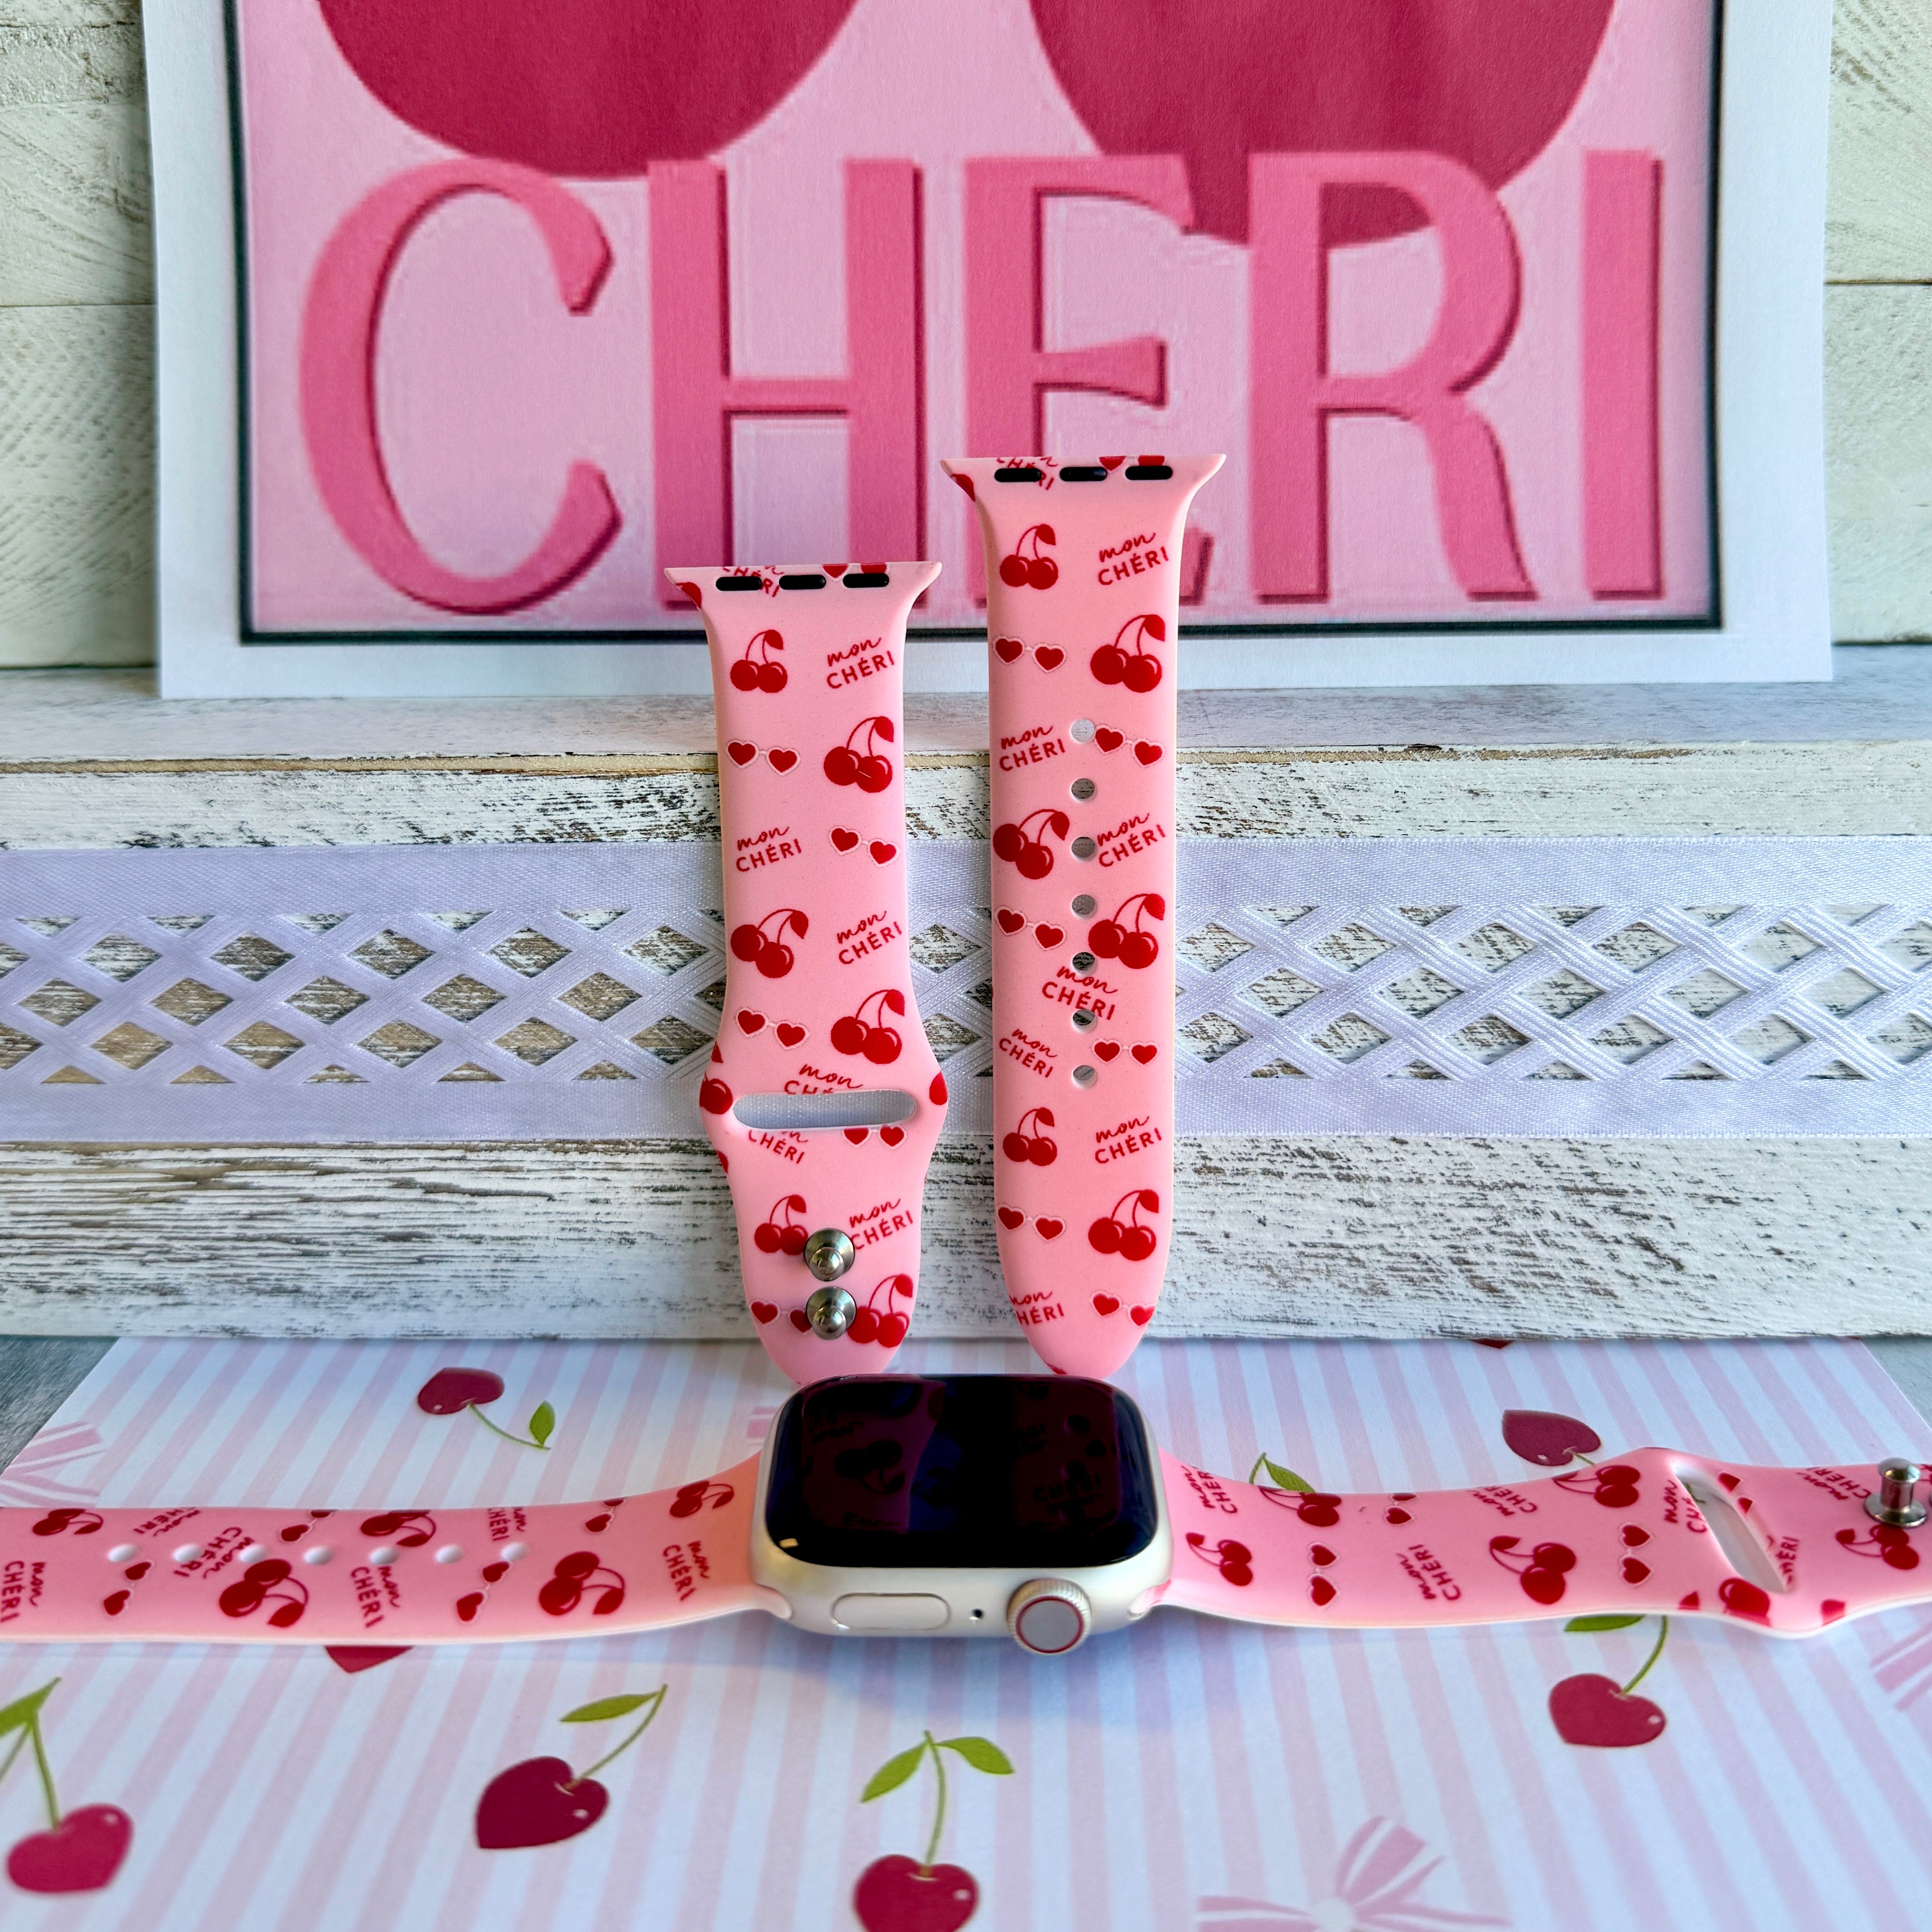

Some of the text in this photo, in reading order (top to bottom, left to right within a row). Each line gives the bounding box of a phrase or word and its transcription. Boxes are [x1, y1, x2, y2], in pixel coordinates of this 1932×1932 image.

[298, 148, 1664, 615] CHERI
[1097, 546, 1169, 586] CHÉRI
[1099, 533, 1156, 563] mon
[826, 650, 894, 689] CHÉRI
[827, 637, 882, 667] mon
[999, 738, 1066, 772] CHÉRI
[1001, 726, 1054, 750] mon
[737, 826, 790, 852] mon
[1096, 813, 1150, 847] mon
[1098, 824, 1166, 868] CHÉRI
[735, 838, 802, 872] CHÉRI
[836, 910, 887, 944] mon
[838, 921, 902, 965] CHÉRI
[1056, 966, 1118, 994] mon
[1042, 981, 1116, 1021] CHÉRI
[997, 1037, 1054, 1078] CHÉRI
[1011, 1028, 1058, 1058] mon
[798, 1063, 863, 1089] mon
[1094, 1127, 1162, 1164] CHÉRI
[1095, 1116, 1150, 1144] mon
[849, 1198, 901, 1228] mon
[850, 1210, 913, 1250] CHÉRI
[1016, 1302, 1065, 1325] HÉRI
[1181, 1465, 1216, 1509] mon
[1196, 1470, 1238, 1514] CHÉR
[1663, 1480, 1679, 1524] mon
[488, 1508, 511, 1541] HÉRI
[173, 1526, 242, 1578] CHÉRI
[202, 1536, 255, 1580] mon
[687, 1540, 710, 1579] mon
[0, 1560, 26, 1623] CHÉRI
[29, 1562, 46, 1608] mon
[377, 1565, 401, 1608] mon
[663, 1544, 697, 1602] CHÉRI
[1396, 1553, 1437, 1599] mon
[1408, 1544, 1462, 1601] CHÉRI
[350, 1566, 384, 1629] CHÉRI
